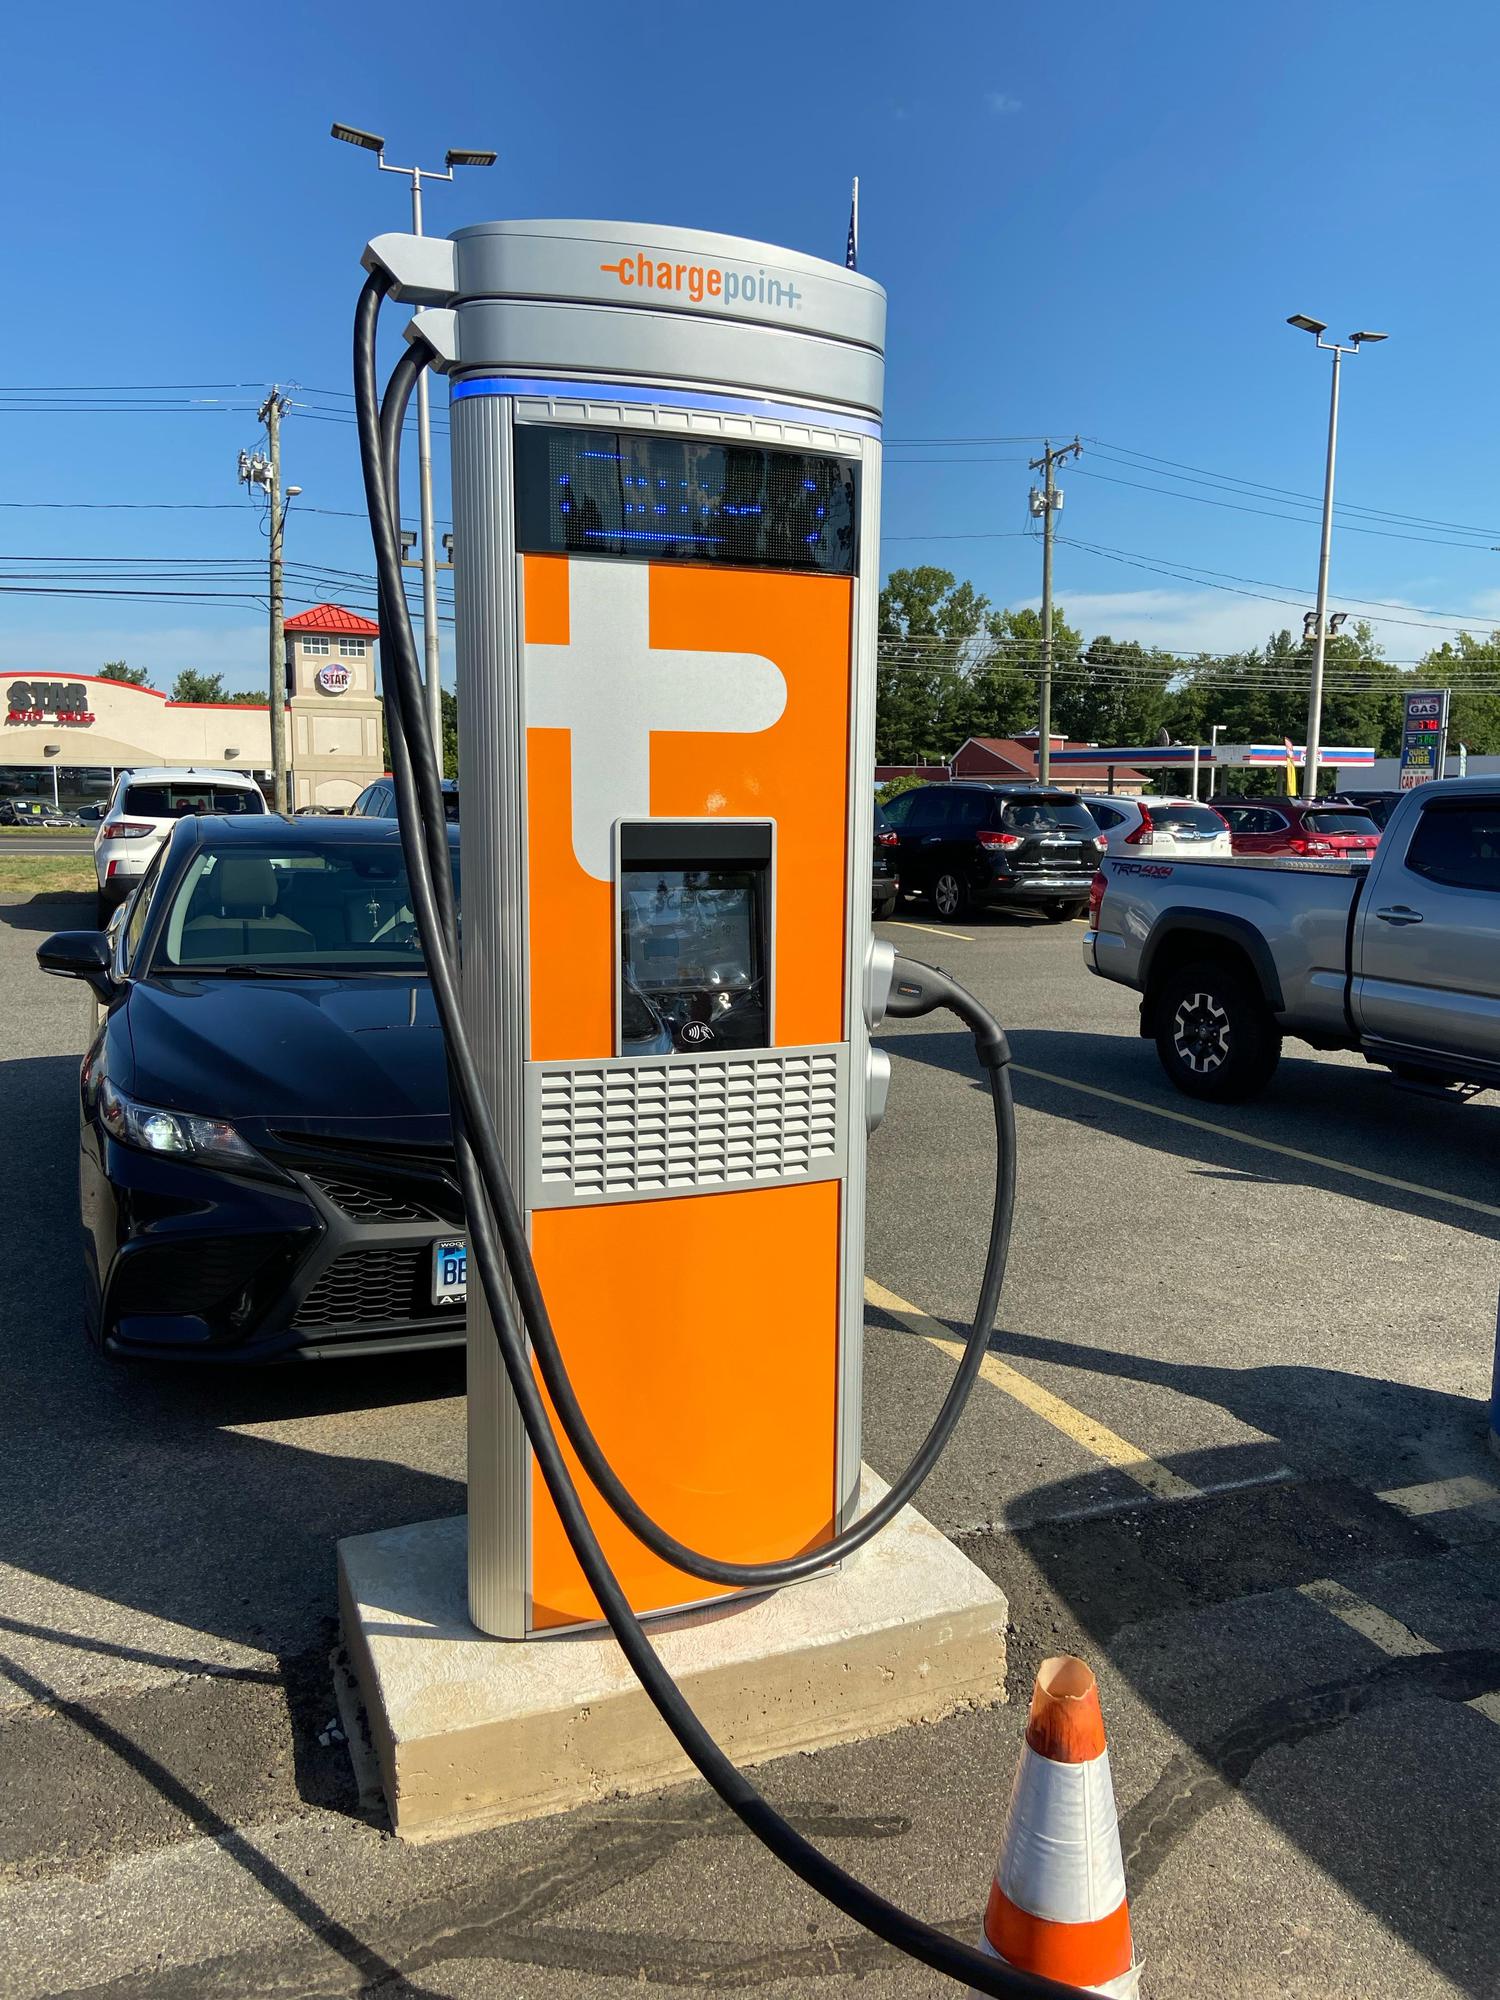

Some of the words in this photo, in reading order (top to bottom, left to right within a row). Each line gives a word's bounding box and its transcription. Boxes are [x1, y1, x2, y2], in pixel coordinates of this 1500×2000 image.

[600, 253, 802, 309] chargepoint
[323, 674, 348, 685] STAR
[7, 681, 88, 712] STAR
[1410, 704, 1437, 713] GAS
[1407, 756, 1430, 765] LUBE
[1402, 775, 1414, 789] CAR
[1112, 862, 1141, 875] TRD
